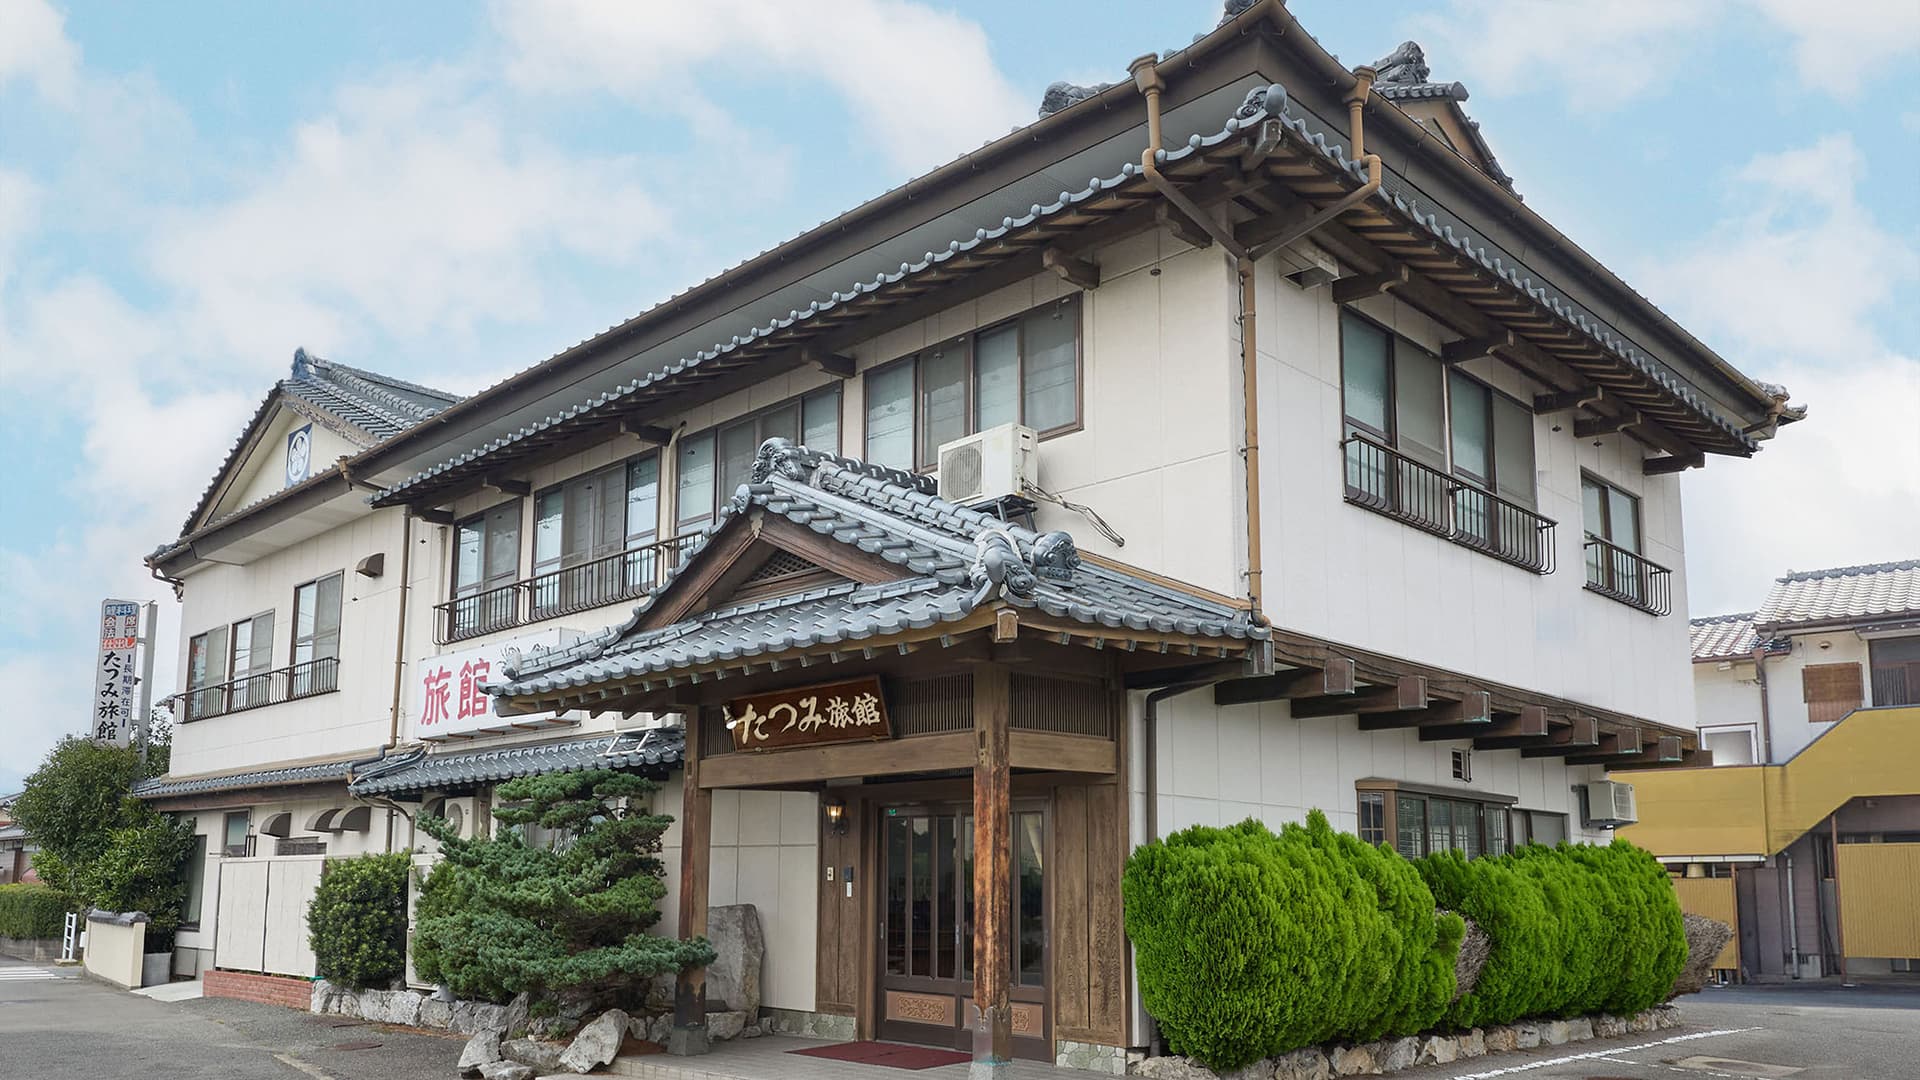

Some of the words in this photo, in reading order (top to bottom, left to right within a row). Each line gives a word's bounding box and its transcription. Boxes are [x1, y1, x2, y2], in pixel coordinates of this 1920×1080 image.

[103, 638, 136, 650] 仕出し
[96, 651, 121, 741] たつみ旅館
[421, 658, 490, 725] 旅館
[734, 692, 881, 745] たつみ旅館
